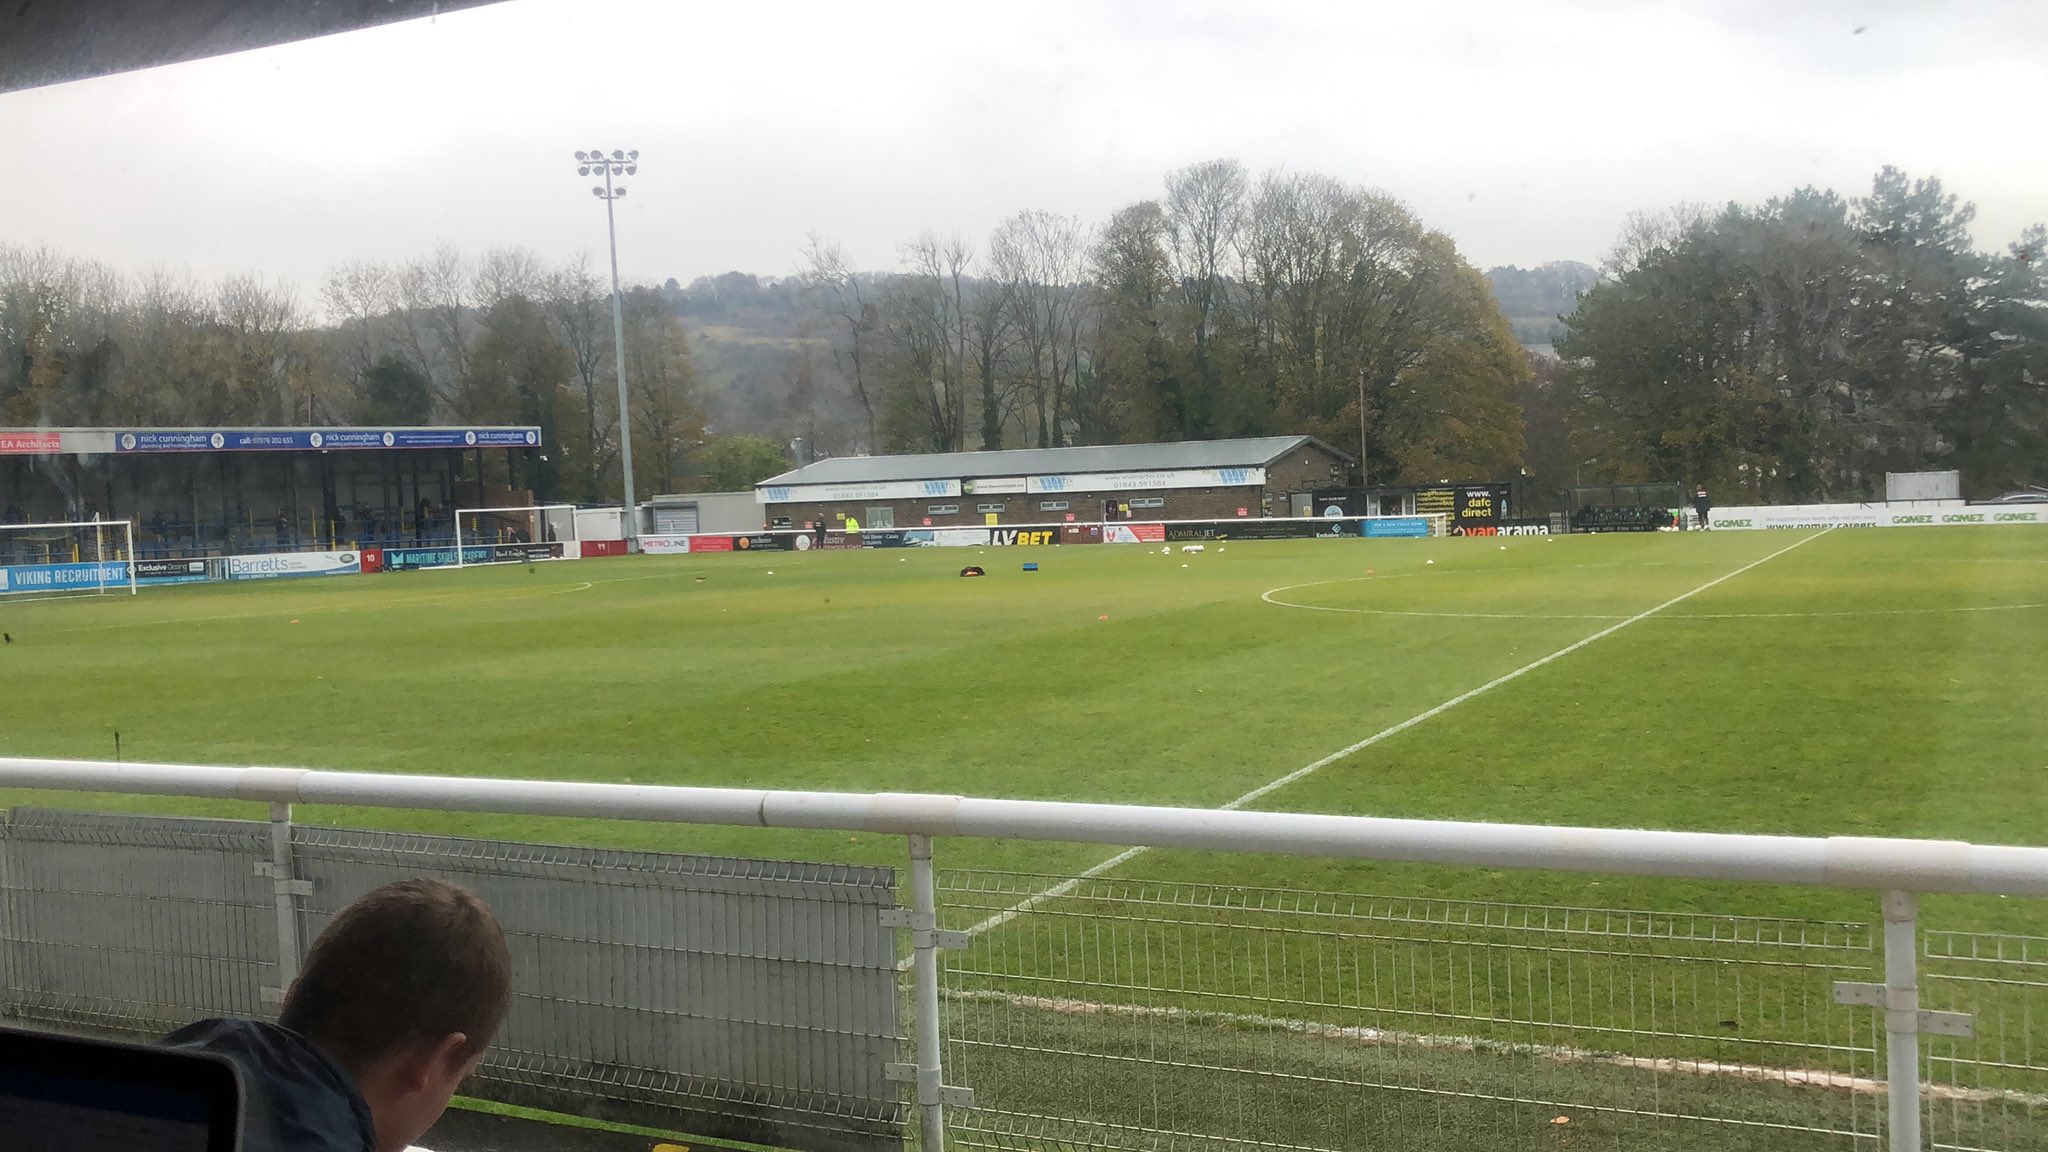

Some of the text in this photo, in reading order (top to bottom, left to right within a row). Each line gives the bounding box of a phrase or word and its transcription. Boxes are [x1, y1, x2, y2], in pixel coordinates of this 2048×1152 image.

[141, 434, 206, 444] nick cunningham
[340, 432, 380, 442] cunningham
[16, 440, 60, 448] Architects
[1468, 498, 1492, 508] dafc
[1462, 508, 1492, 518] direct
[1942, 514, 1984, 522] GOMEZ
[1994, 512, 2037, 521] GOMEZ
[1714, 519, 1752, 527] GOMEZ
[1892, 515, 1933, 524] GOMEZ
[1467, 525, 1548, 536] vanarama
[406, 553, 436, 564] MARITIME
[463, 551, 487, 560] CADEMY
[232, 557, 288, 572] Barretts
[15, 571, 52, 585] VIKING
